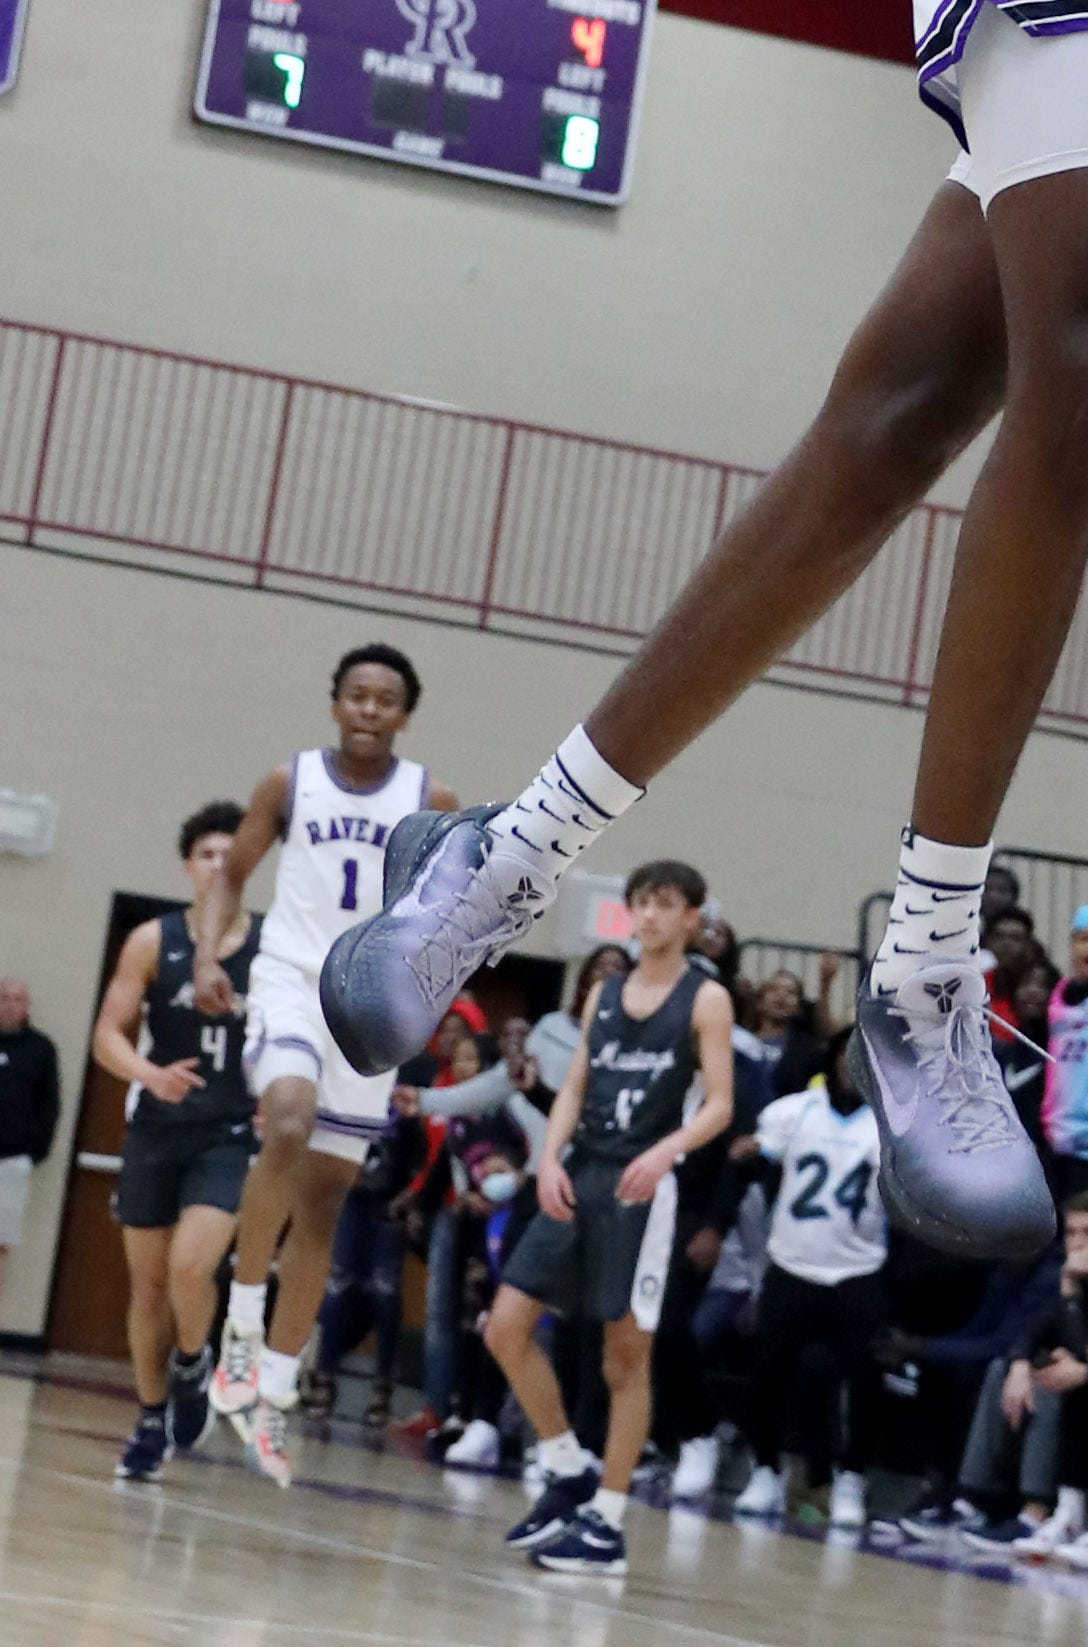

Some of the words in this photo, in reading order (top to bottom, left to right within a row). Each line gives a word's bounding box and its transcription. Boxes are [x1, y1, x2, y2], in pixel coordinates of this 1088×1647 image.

[571, 16, 607, 68] 4
[272, 52, 306, 109] 7
[561, 113, 600, 171] 8
[306, 816, 390, 848] RAVEN
[340, 858, 358, 910] 1
[200, 1025, 228, 1072] 4
[790, 1152, 874, 1226] 24
